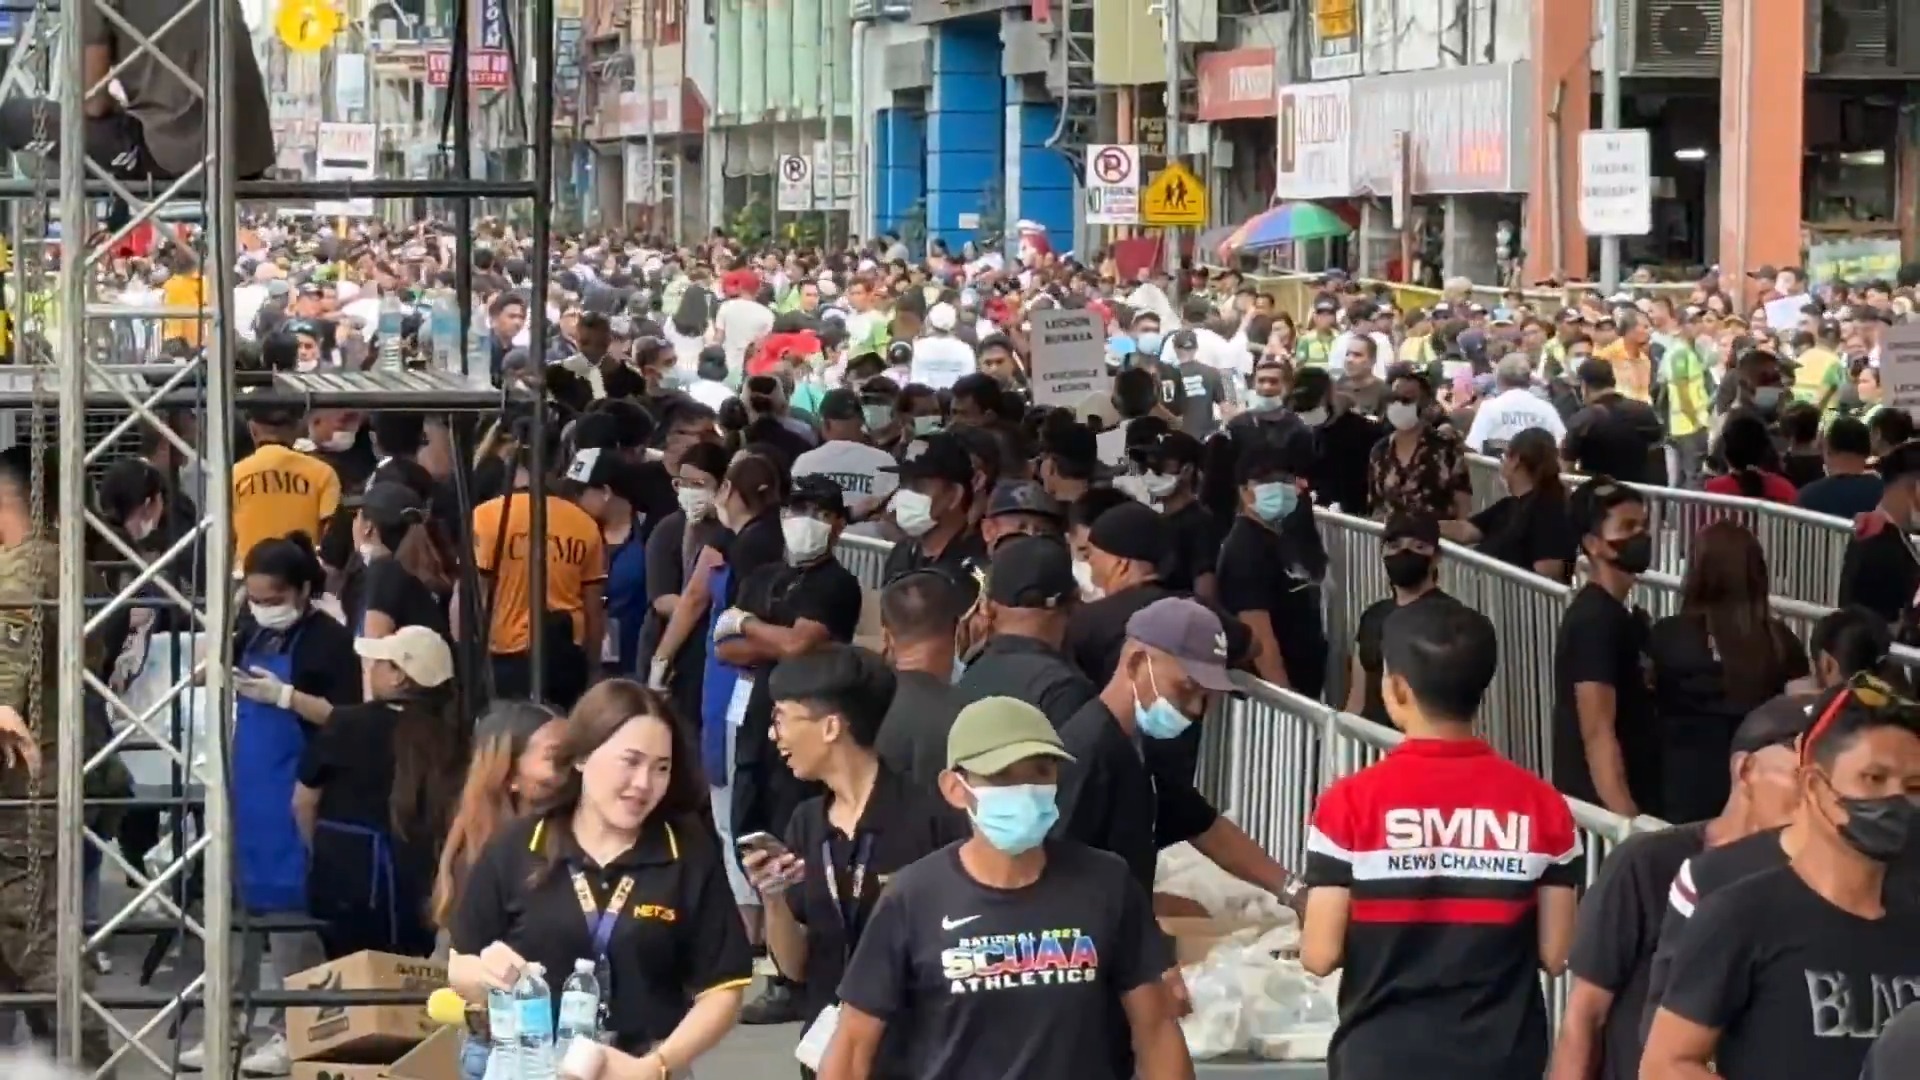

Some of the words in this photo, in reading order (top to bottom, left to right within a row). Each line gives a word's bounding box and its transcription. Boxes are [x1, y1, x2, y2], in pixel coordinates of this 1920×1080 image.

[1385, 807, 1531, 853] SMNI
[1388, 853, 1437, 871] NEWS
[1440, 853, 1527, 875] CHANNEL
[941, 934, 1099, 980] SCUAA
[950, 968, 1097, 995] ATHLETICS
